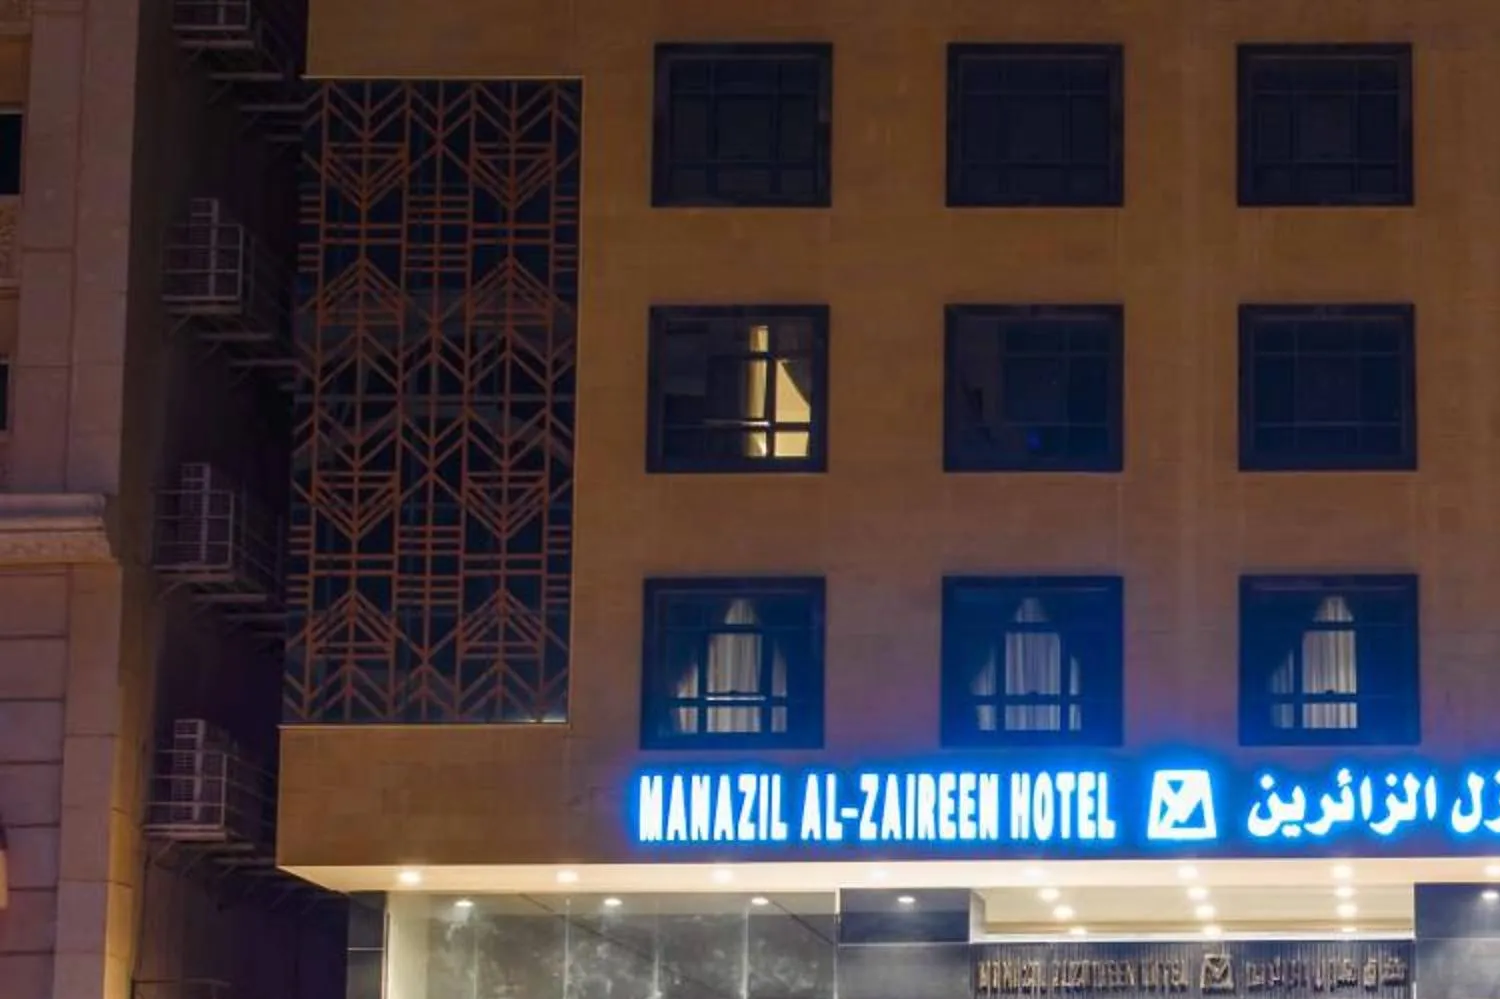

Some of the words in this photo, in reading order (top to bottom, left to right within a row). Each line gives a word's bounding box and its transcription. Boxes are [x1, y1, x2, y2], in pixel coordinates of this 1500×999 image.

[639, 773, 788, 842] MANAZIL
[801, 772, 1000, 842] AL-ZAIREEN
[1010, 771, 1117, 840] HOTEL
[1247, 768, 1437, 838] الزائرين
